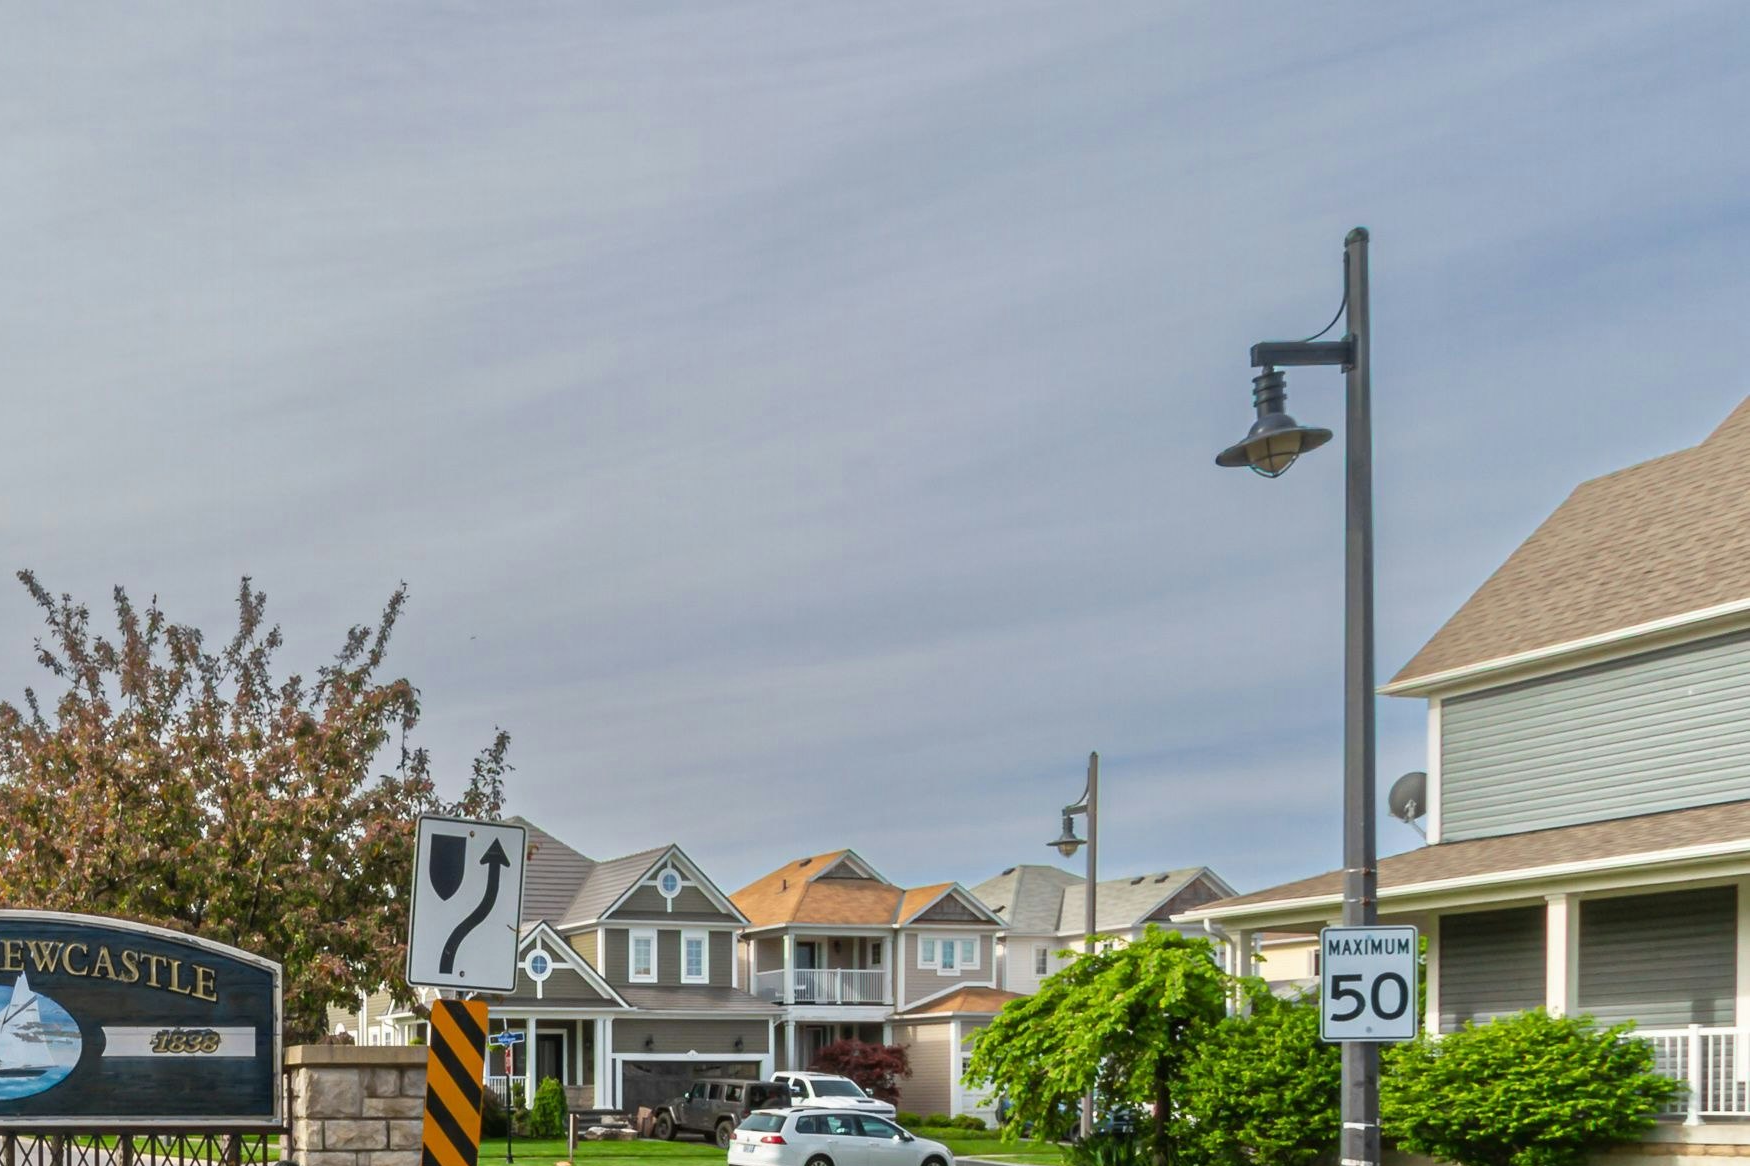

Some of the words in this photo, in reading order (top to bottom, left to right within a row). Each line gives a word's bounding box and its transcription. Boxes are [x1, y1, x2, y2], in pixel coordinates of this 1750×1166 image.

[1329, 938, 1409, 956] MAXIMUM
[1331, 972, 1409, 1022] 50
[152, 1028, 221, 1053] 1838
